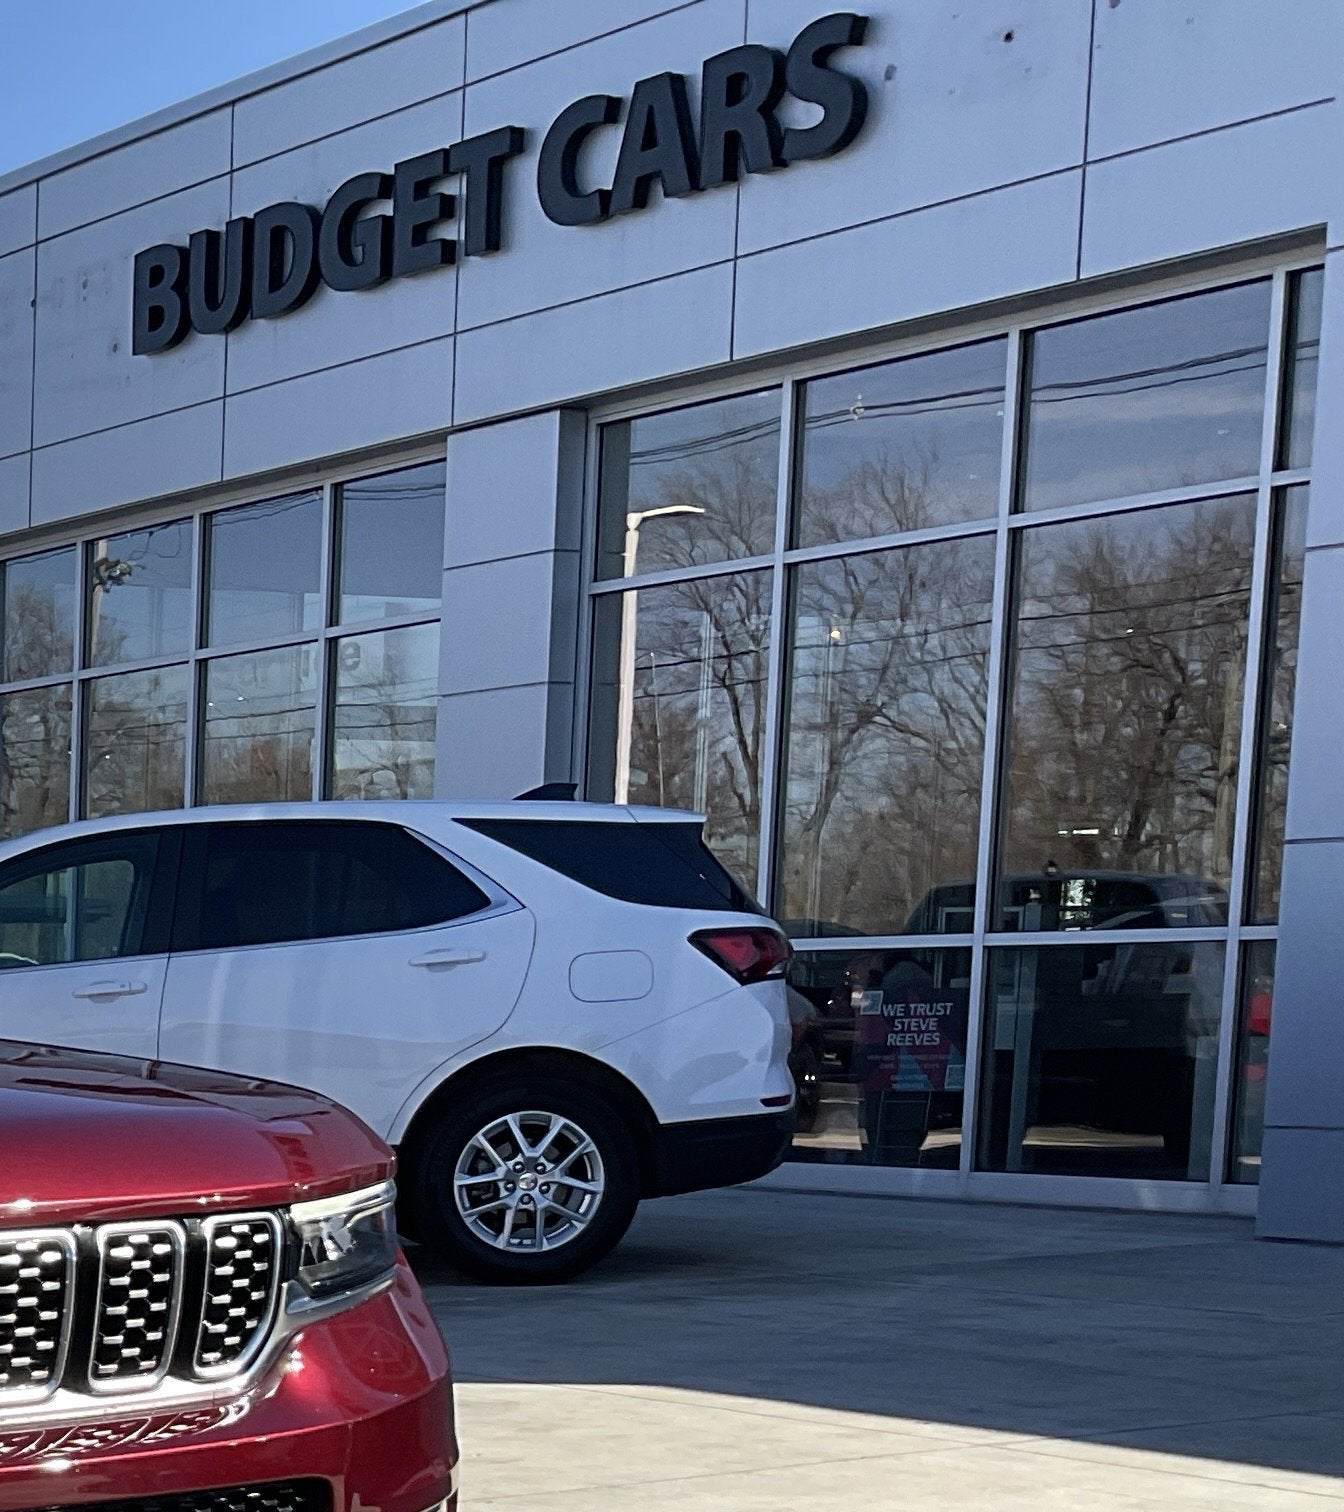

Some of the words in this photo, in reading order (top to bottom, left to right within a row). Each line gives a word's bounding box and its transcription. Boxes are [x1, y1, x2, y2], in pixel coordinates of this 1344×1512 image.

[132, 125, 525, 356] BUDGET
[537, 12, 871, 228] CARS
[882, 1003, 906, 1017] WE
[909, 1002, 954, 1016] TRUST
[893, 1018, 939, 1031] STEVE
[887, 1032, 941, 1047] REEVES
